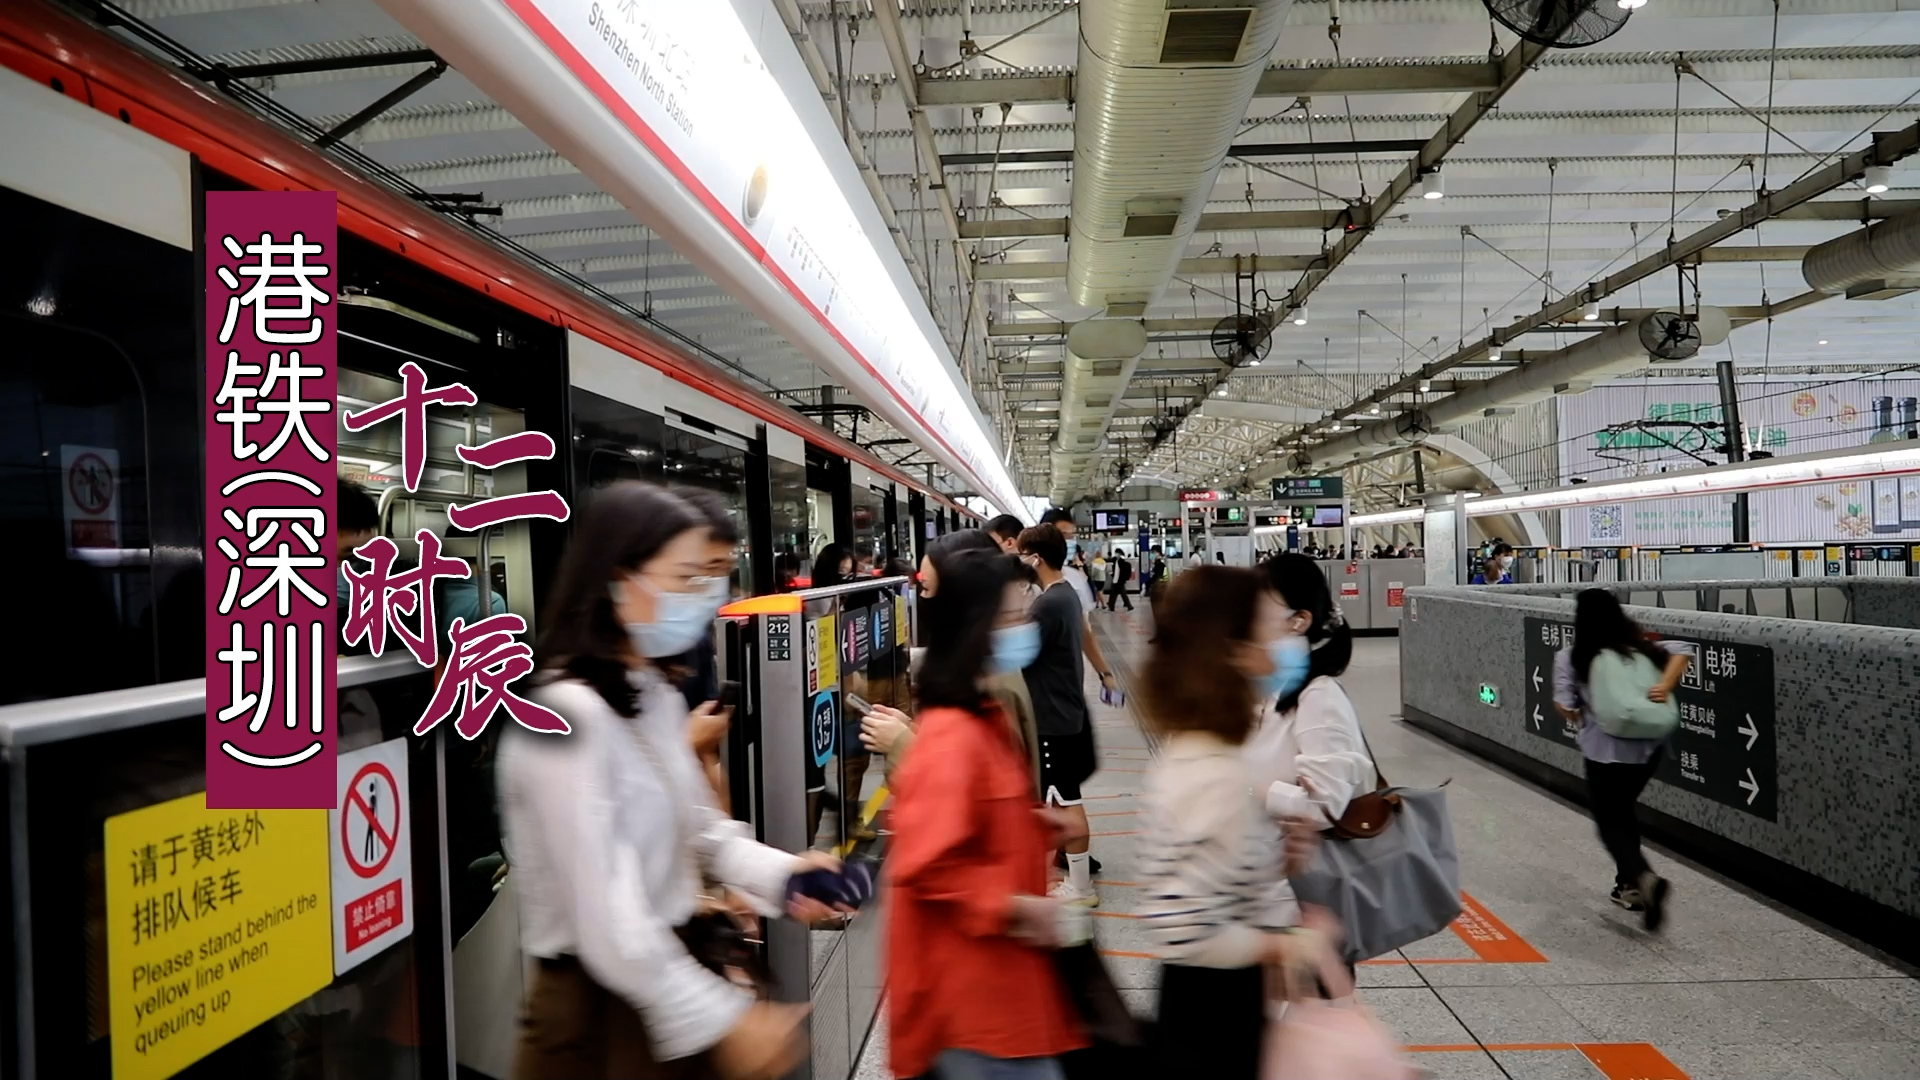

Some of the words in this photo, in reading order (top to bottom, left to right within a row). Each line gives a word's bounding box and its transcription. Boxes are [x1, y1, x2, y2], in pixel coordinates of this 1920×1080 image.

[588, 1, 640, 76] Shenzhen
[638, 61, 665, 105] North
[665, 92, 694, 139] Station
[1648, 401, 1722, 422] 德国原
[768, 622, 790, 634] 212
[782, 639, 788, 648] 4
[1541, 623, 1560, 647] 电梯
[782, 651, 788, 659] 4
[1705, 645, 1737, 679] 电梯
[1704, 680, 1716, 693] Lift
[817, 714, 823, 750] 3
[131, 811, 265, 888] 请于黄线外
[132, 868, 244, 946] 排队候车
[132, 949, 194, 992] Please
[199, 926, 242, 960] stand
[246, 907, 294, 938] behind
[297, 891, 317, 917] the
[358, 929, 368, 941] No
[133, 979, 193, 1027] yellow
[195, 963, 224, 991] line
[229, 939, 269, 974] when
[134, 1001, 207, 1054] queuing
[211, 989, 231, 1014] up
